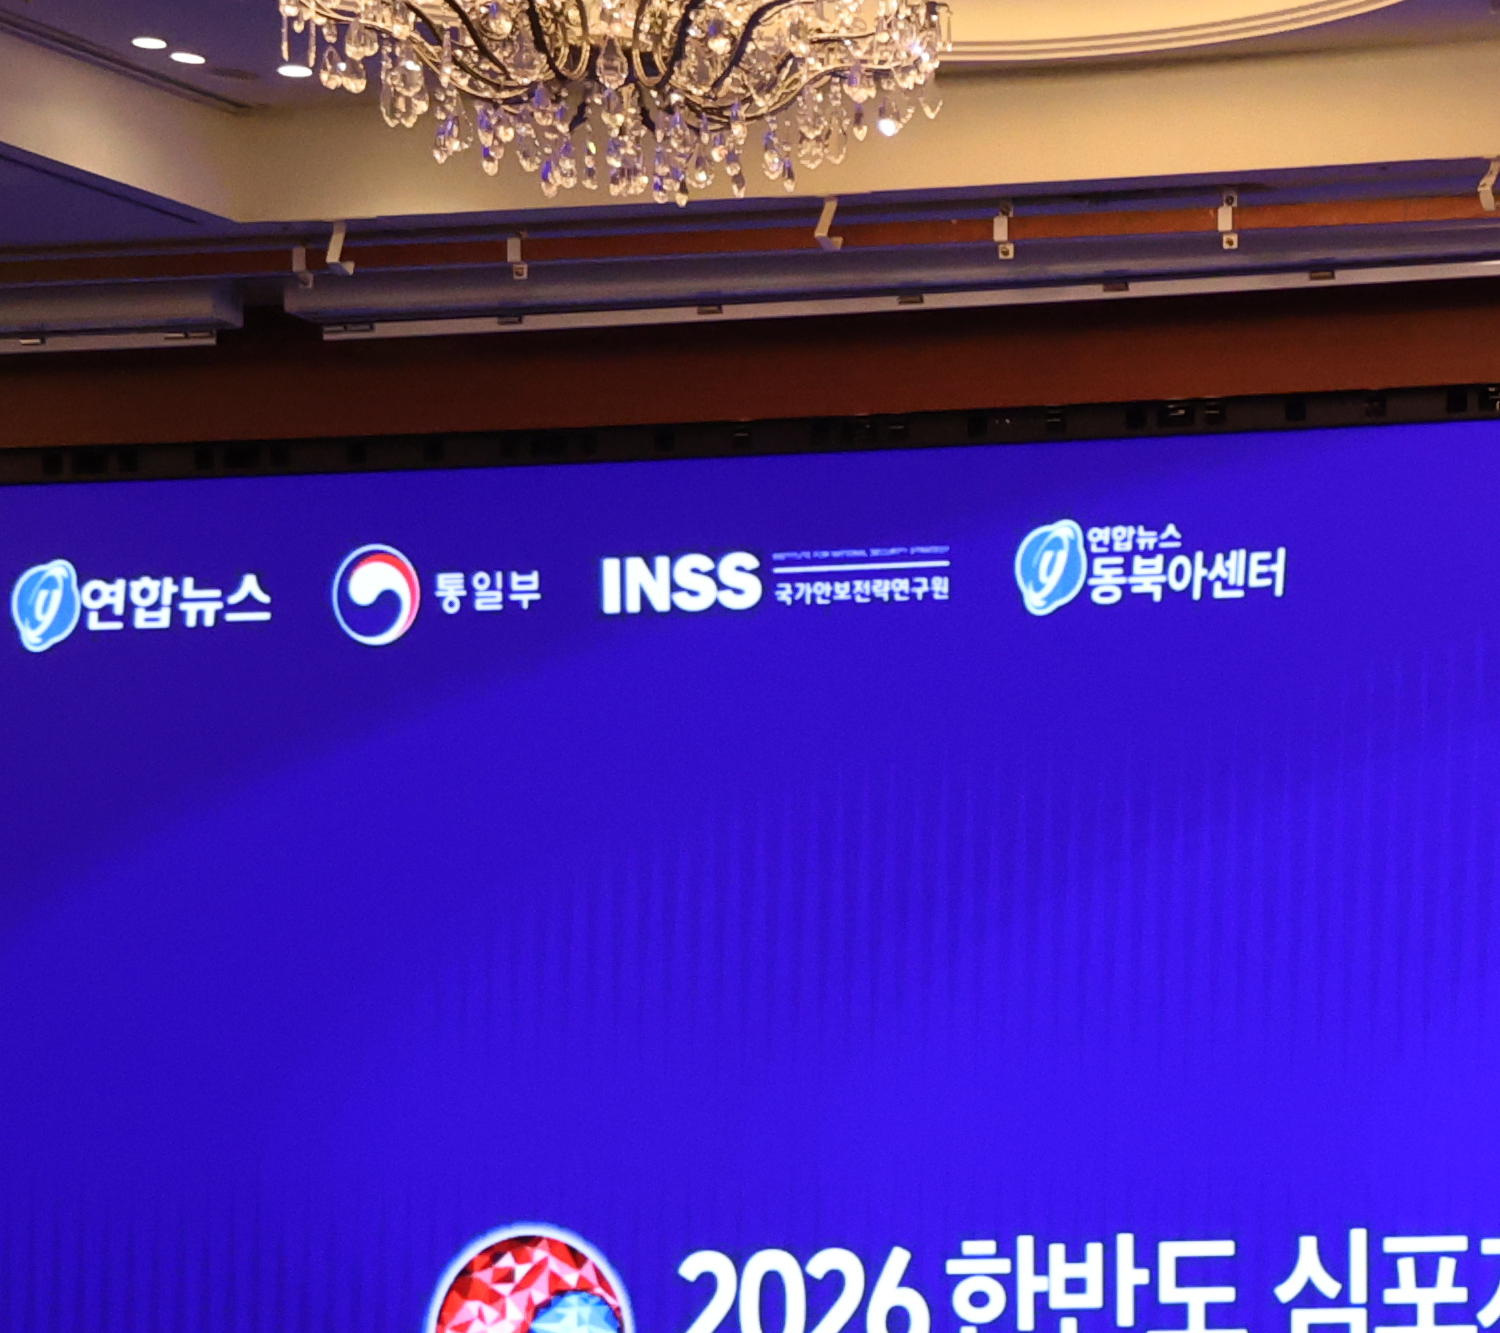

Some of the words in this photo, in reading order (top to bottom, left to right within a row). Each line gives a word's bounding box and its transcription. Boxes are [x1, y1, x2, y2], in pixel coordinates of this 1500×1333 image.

[1087, 522, 1183, 551] 연합뉴스
[436, 571, 540, 613] 통일부
[603, 552, 762, 613] INSS
[774, 575, 950, 606] 국가안보전략연구원
[1087, 545, 1286, 604] 동북아센터
[81, 575, 271, 629] 연합뉴스
